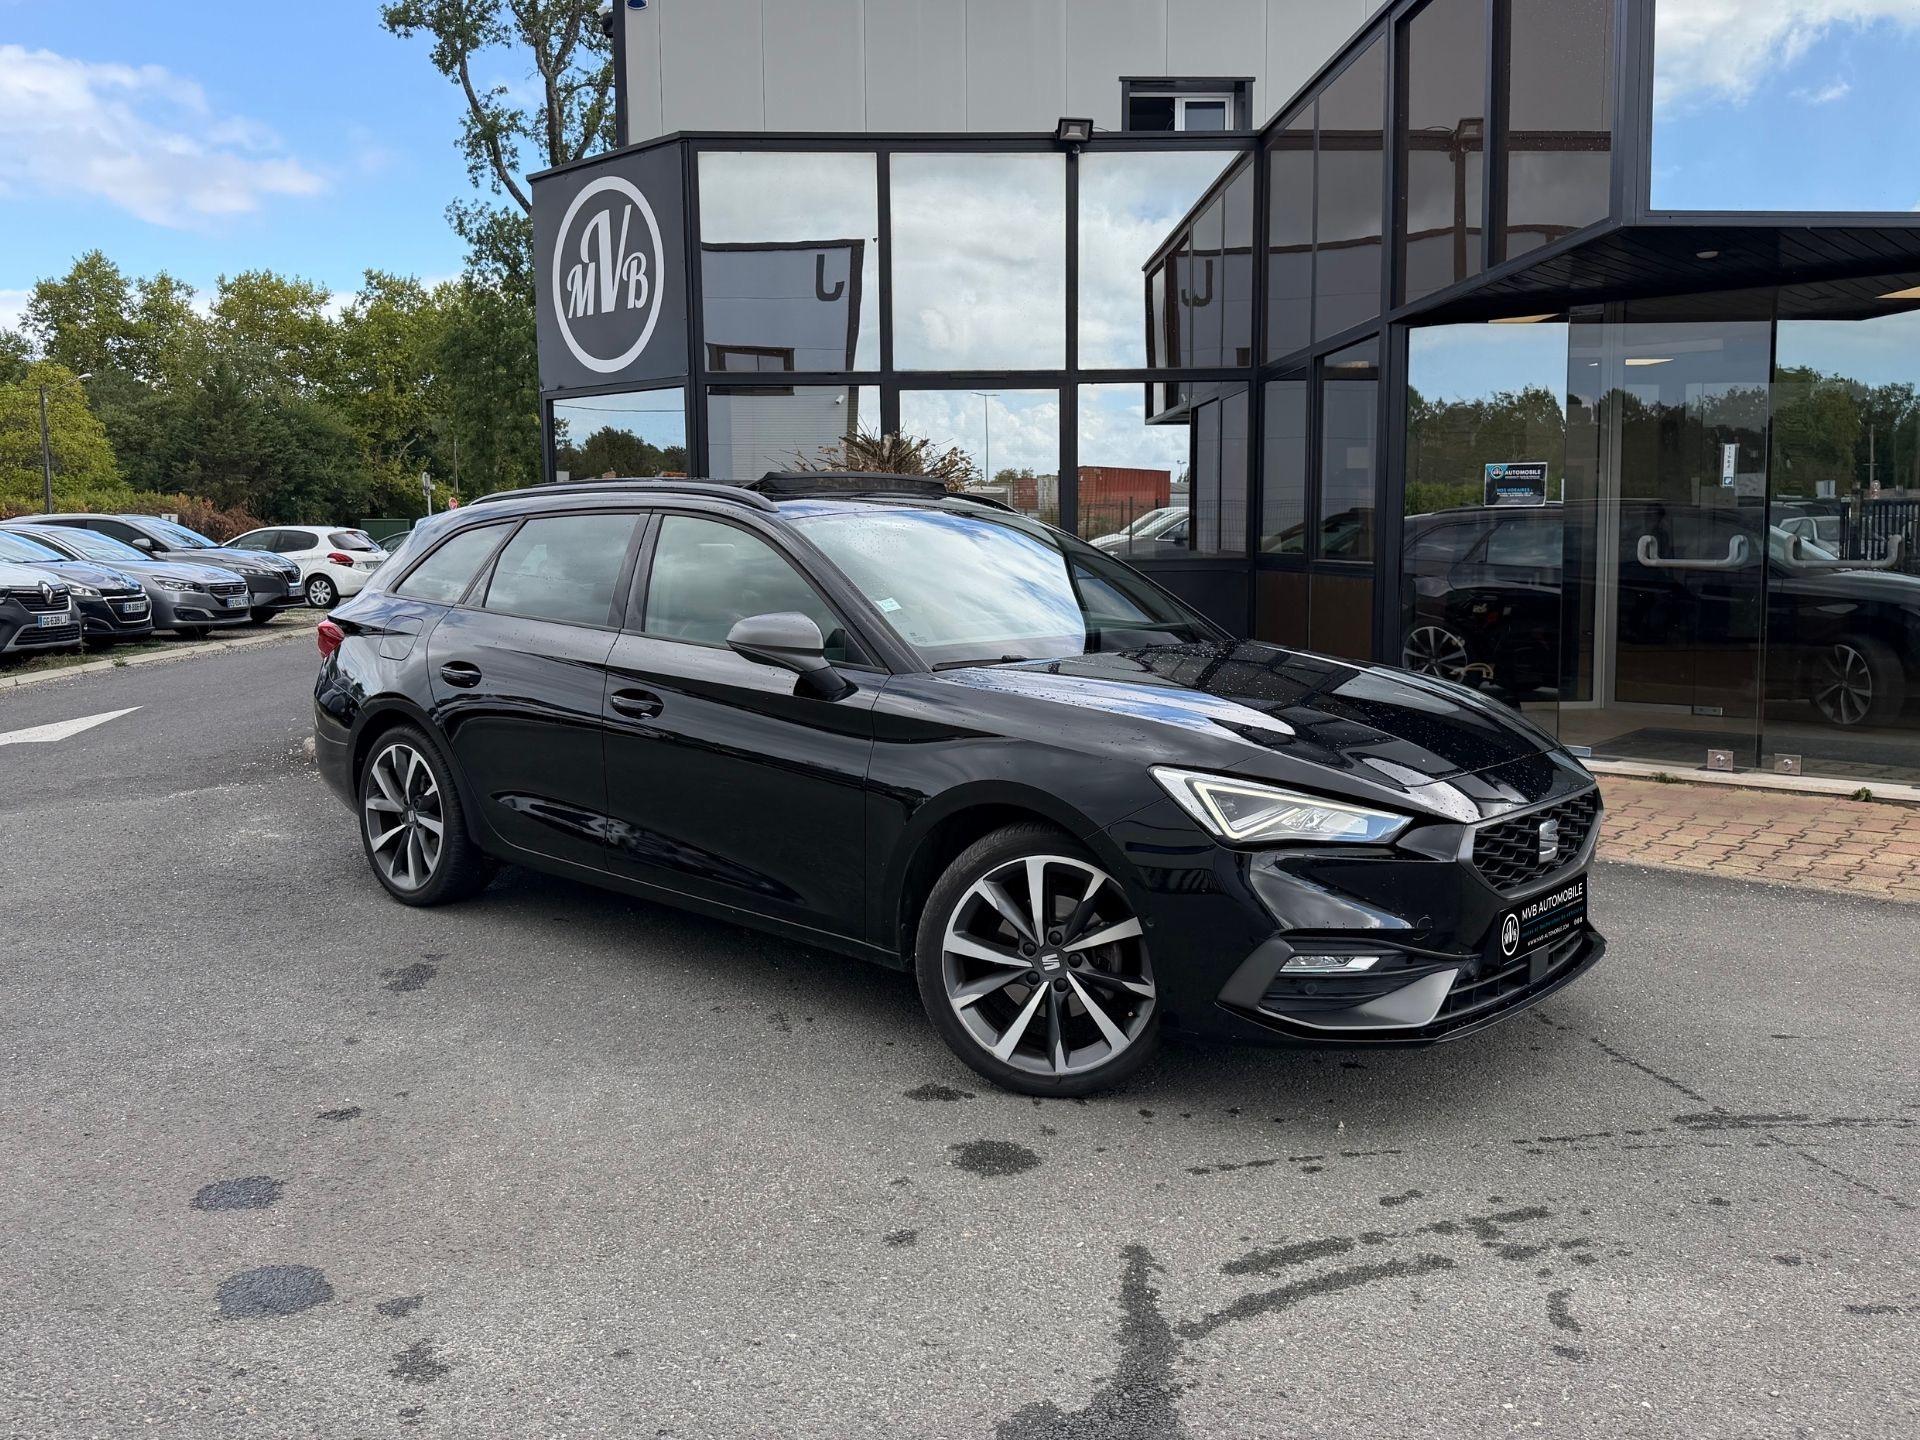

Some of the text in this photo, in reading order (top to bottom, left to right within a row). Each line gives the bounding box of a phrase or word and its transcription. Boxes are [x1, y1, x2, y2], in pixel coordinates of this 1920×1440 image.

[566, 204, 649, 319] MVB
[1521, 904, 1538, 922] MVB
[1538, 882, 1583, 913] AUTOMOBILE
